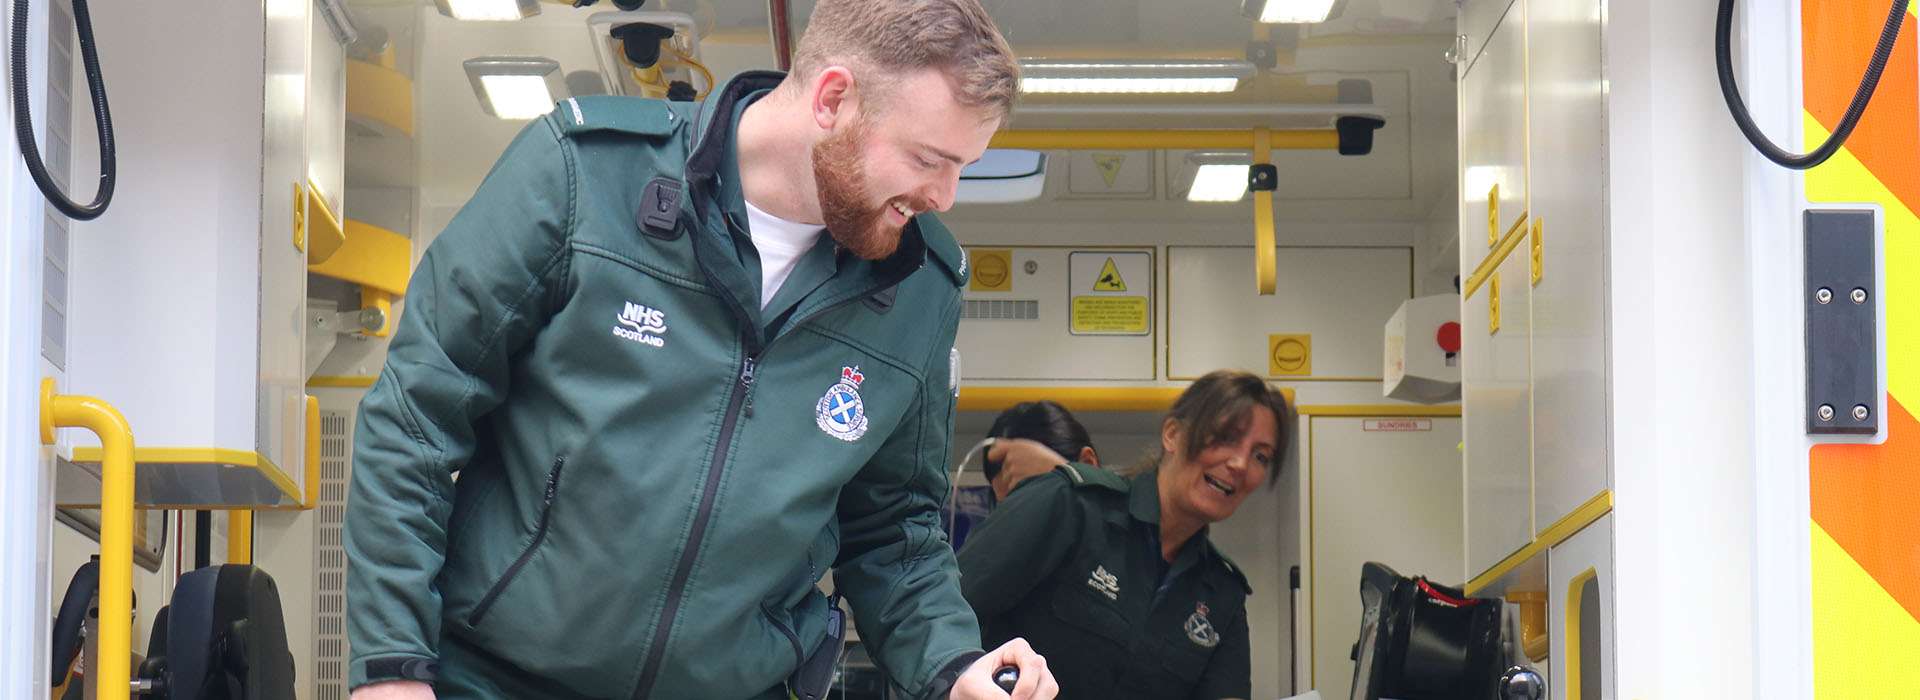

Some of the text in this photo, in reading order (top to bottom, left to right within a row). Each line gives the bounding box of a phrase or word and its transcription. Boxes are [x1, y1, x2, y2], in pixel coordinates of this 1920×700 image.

[623, 301, 664, 328] NHS
[613, 326, 664, 347] SCOTLAND
[1096, 565, 1118, 587] NHS
